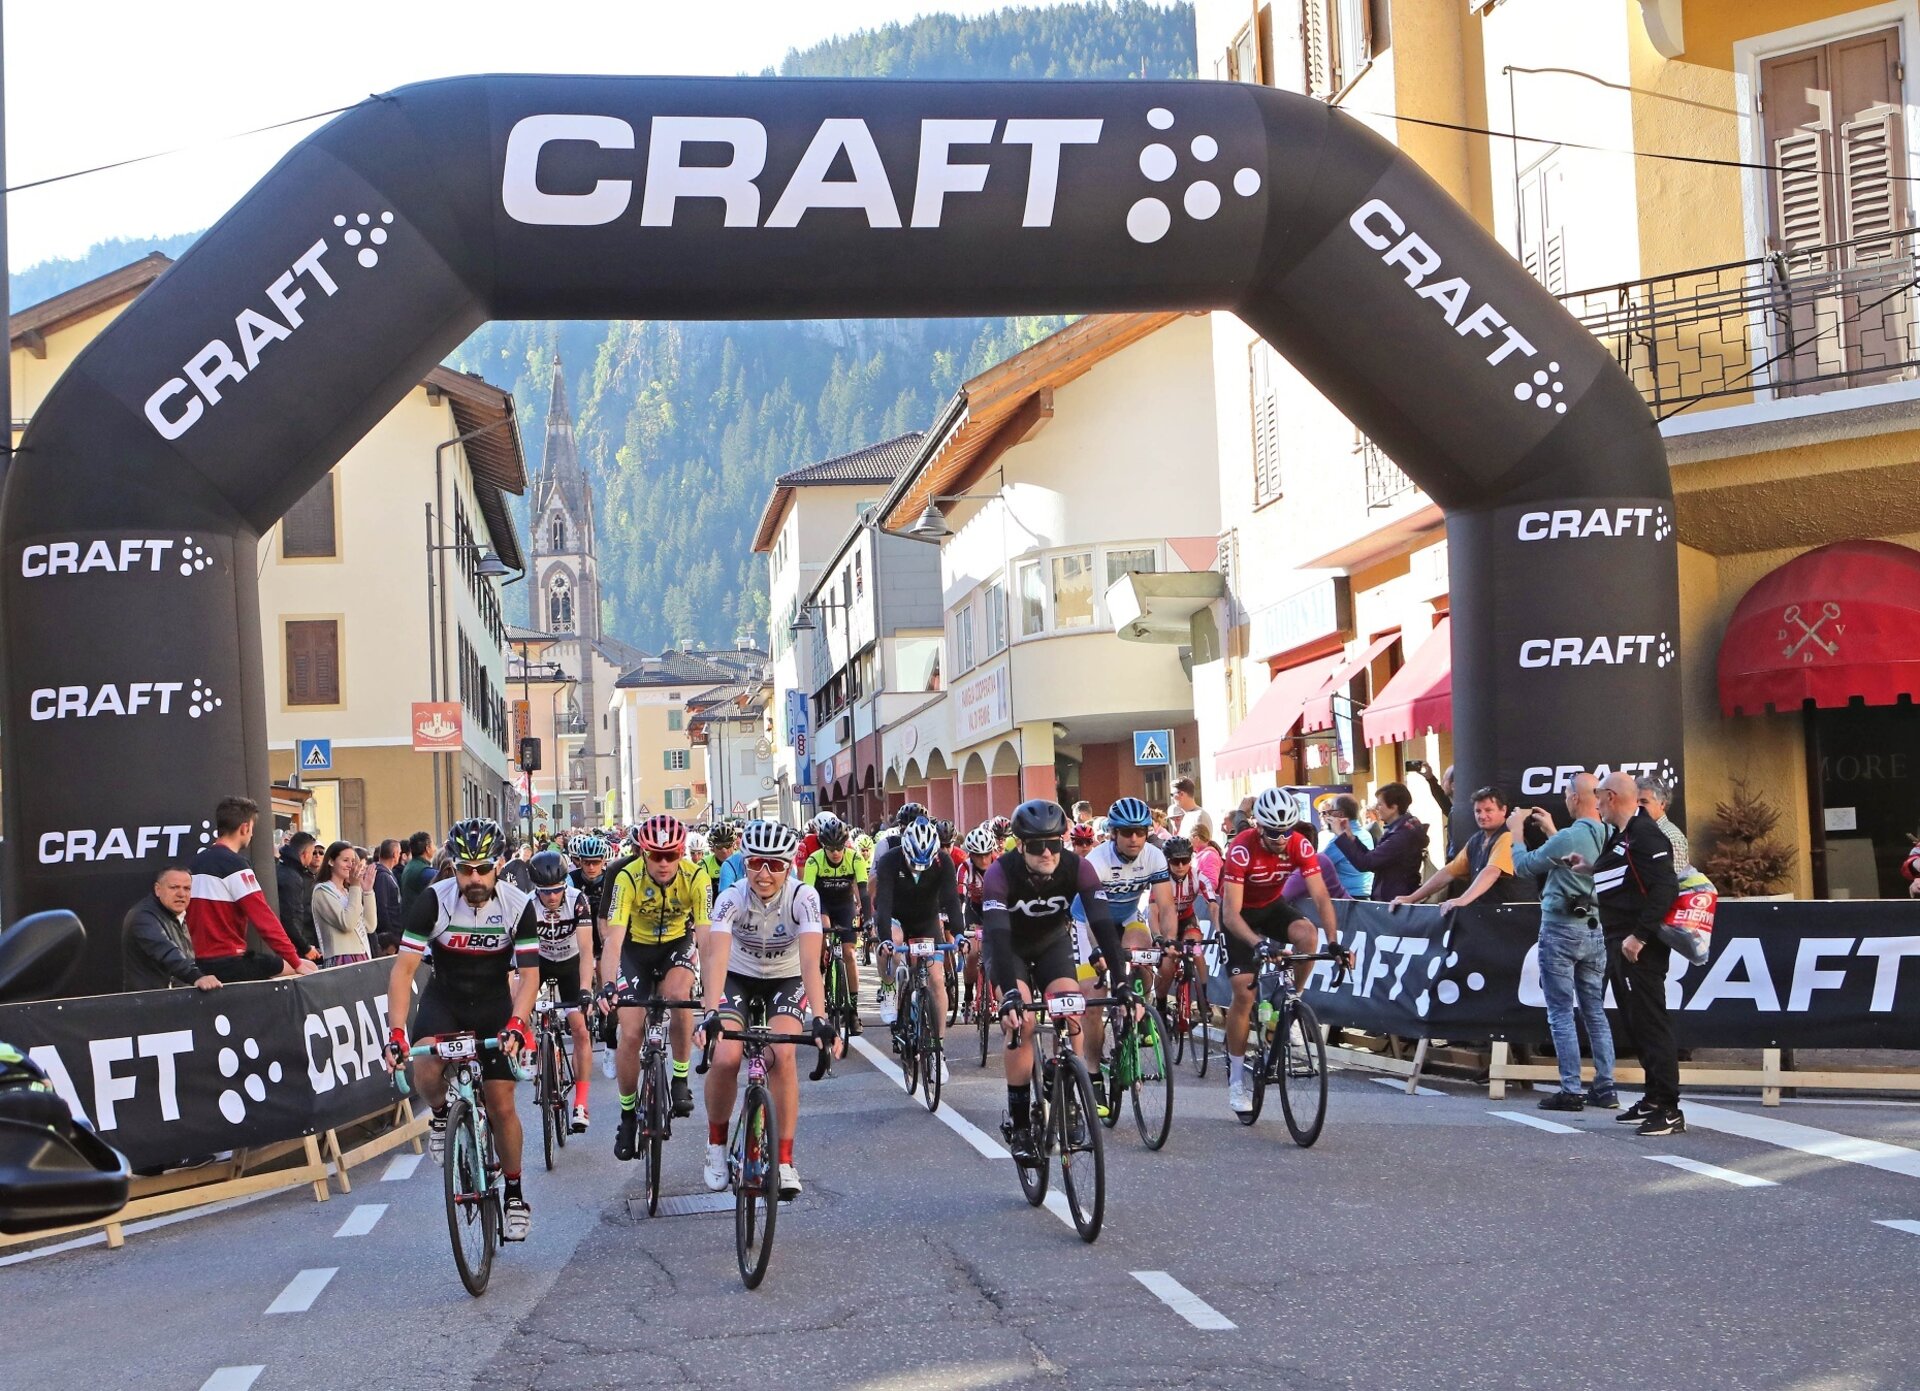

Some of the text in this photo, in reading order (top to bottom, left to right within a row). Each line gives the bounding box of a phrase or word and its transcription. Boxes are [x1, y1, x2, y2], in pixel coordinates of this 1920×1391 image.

[502, 113, 1104, 228] CRAFT
[1349, 198, 1538, 367] CRAFT
[144, 237, 339, 441] CRAFT
[1517, 507, 1653, 541] CRAFT
[21, 539, 174, 578] CRAFT
[1519, 635, 1656, 668] CRAFT
[30, 682, 184, 721] CRAFT
[38, 824, 192, 864] CRAFT
[1140, 953, 1152, 961] 46
[1060, 998, 1075, 1008] 10
[304, 993, 413, 1095] CRAF
[448, 1041, 463, 1053] 59
